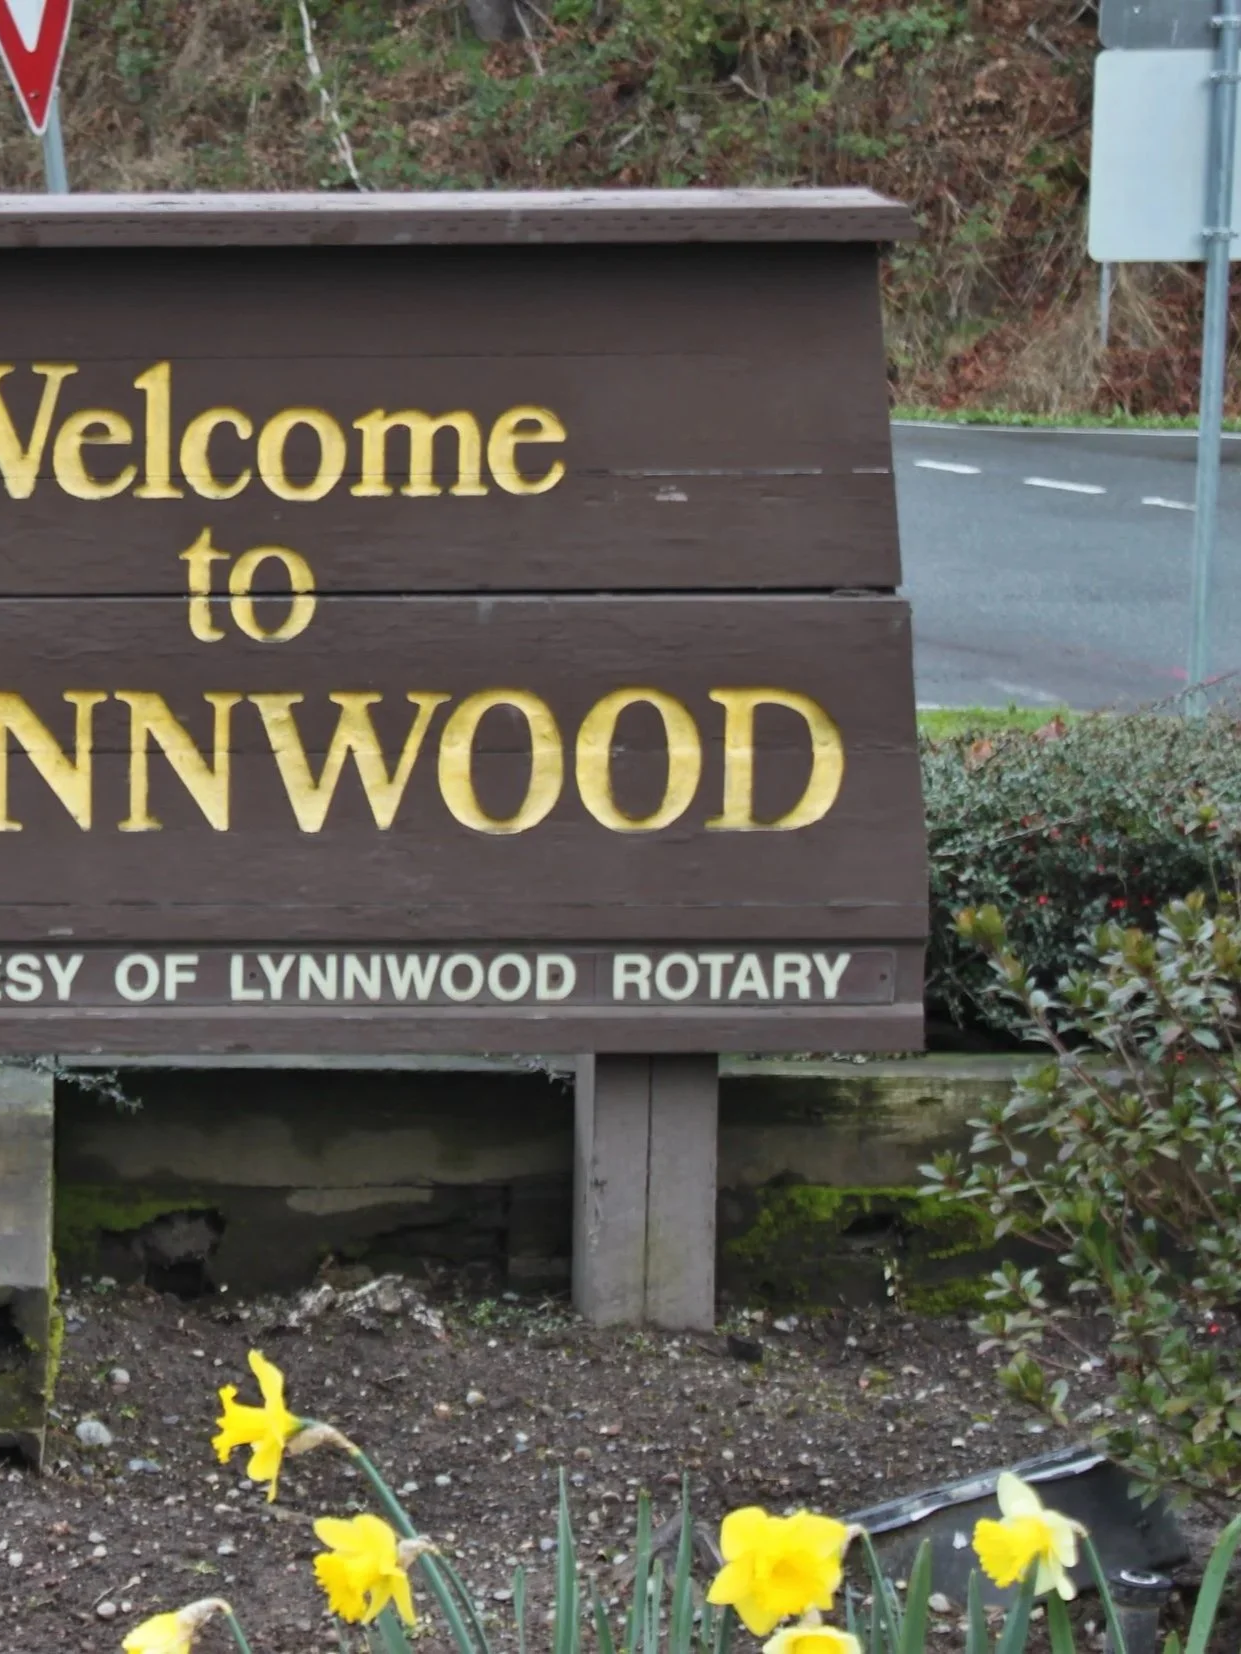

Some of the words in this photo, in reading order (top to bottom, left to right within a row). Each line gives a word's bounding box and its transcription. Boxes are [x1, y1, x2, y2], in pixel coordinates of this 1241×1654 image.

[179, 527, 317, 643] to
[114, 953, 199, 1002] OF
[230, 953, 576, 1002] LYNNWOOD
[612, 953, 852, 1001] ROTARY
